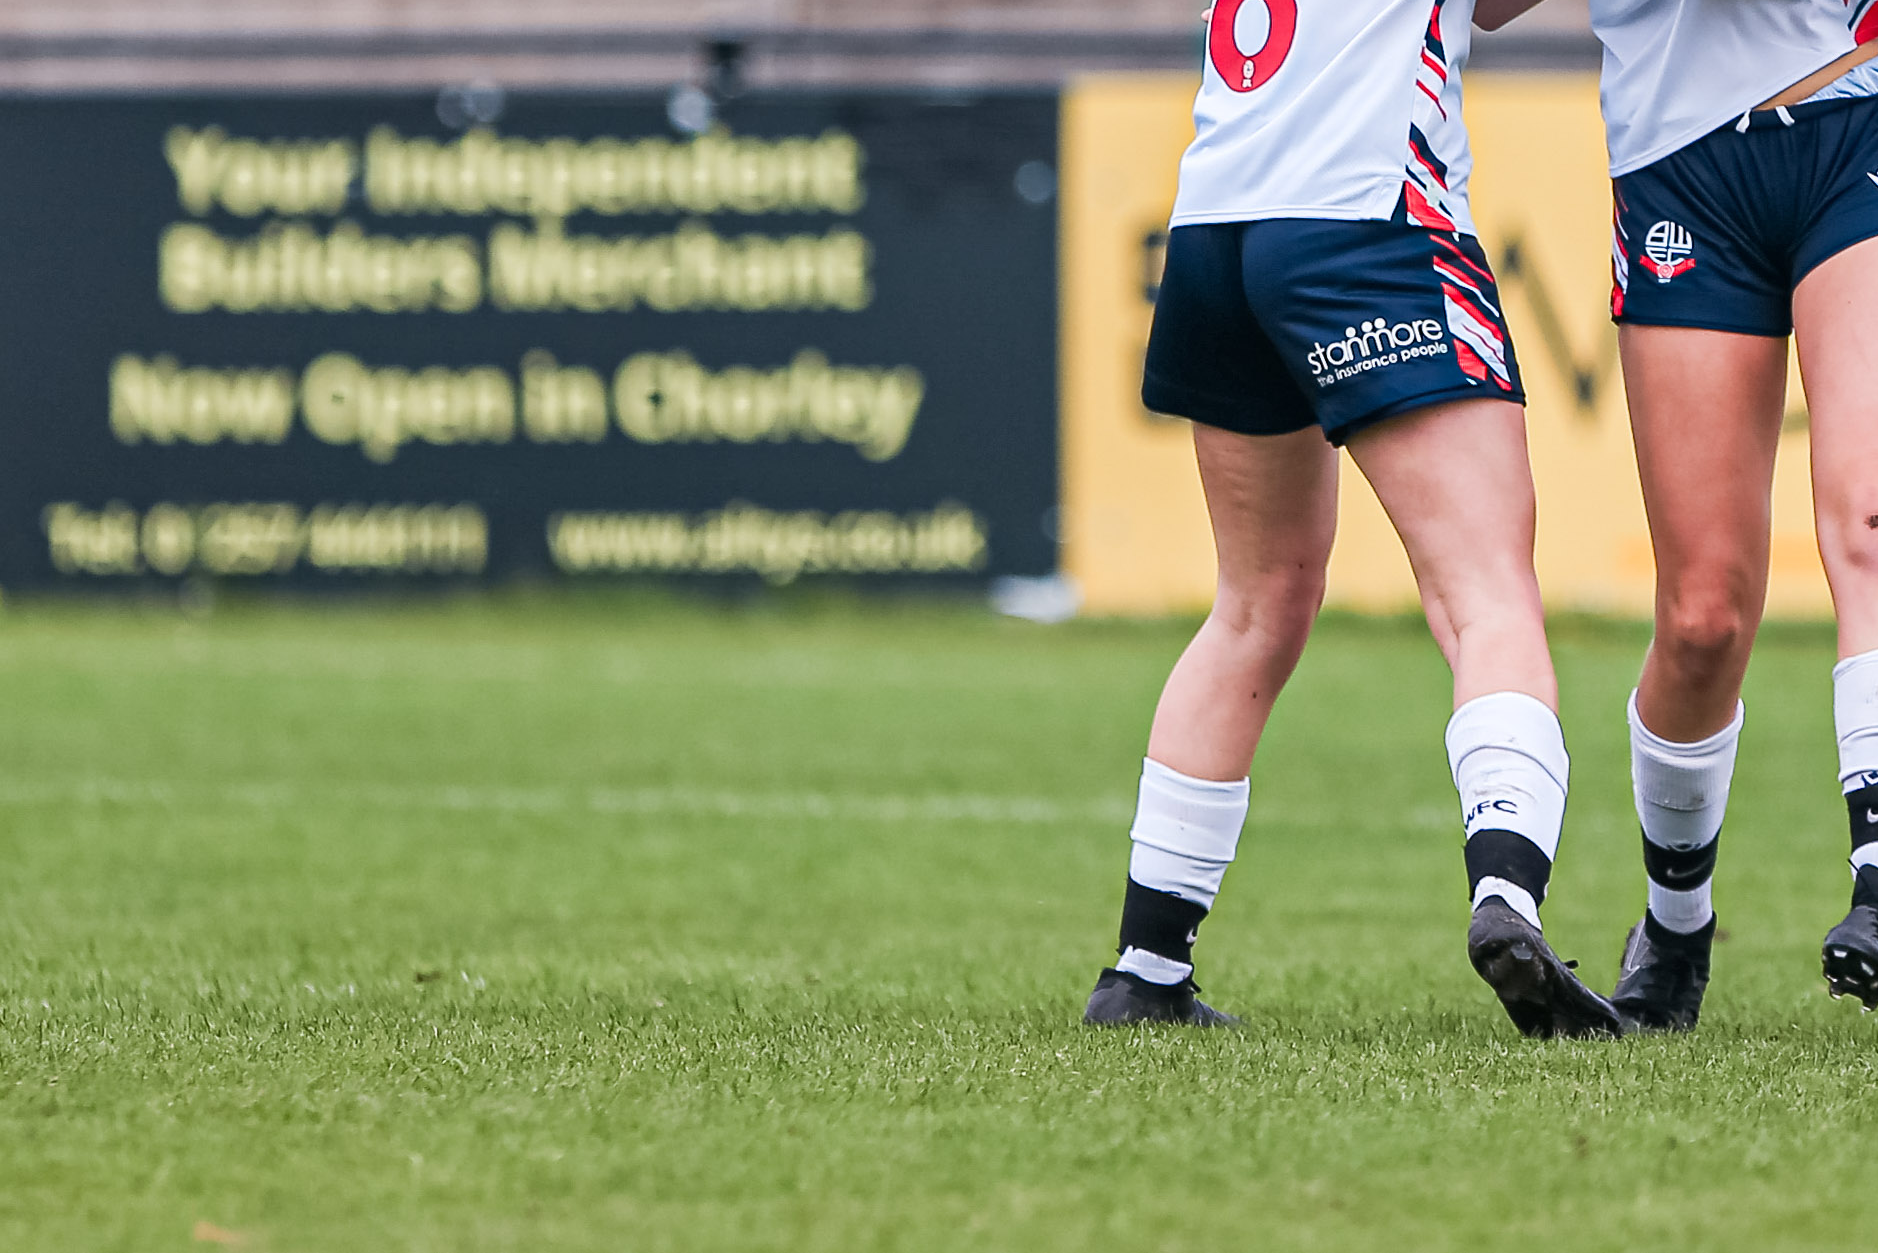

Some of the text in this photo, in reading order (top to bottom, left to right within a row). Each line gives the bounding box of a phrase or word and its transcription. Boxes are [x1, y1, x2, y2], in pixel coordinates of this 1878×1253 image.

[167, 125, 863, 222] Your Independent
[161, 222, 872, 312] Builders Merchant
[1307, 317, 1444, 375] stanmore
[1316, 342, 1448, 388] the insurance people
[111, 350, 925, 461] Now Open in Chorley
